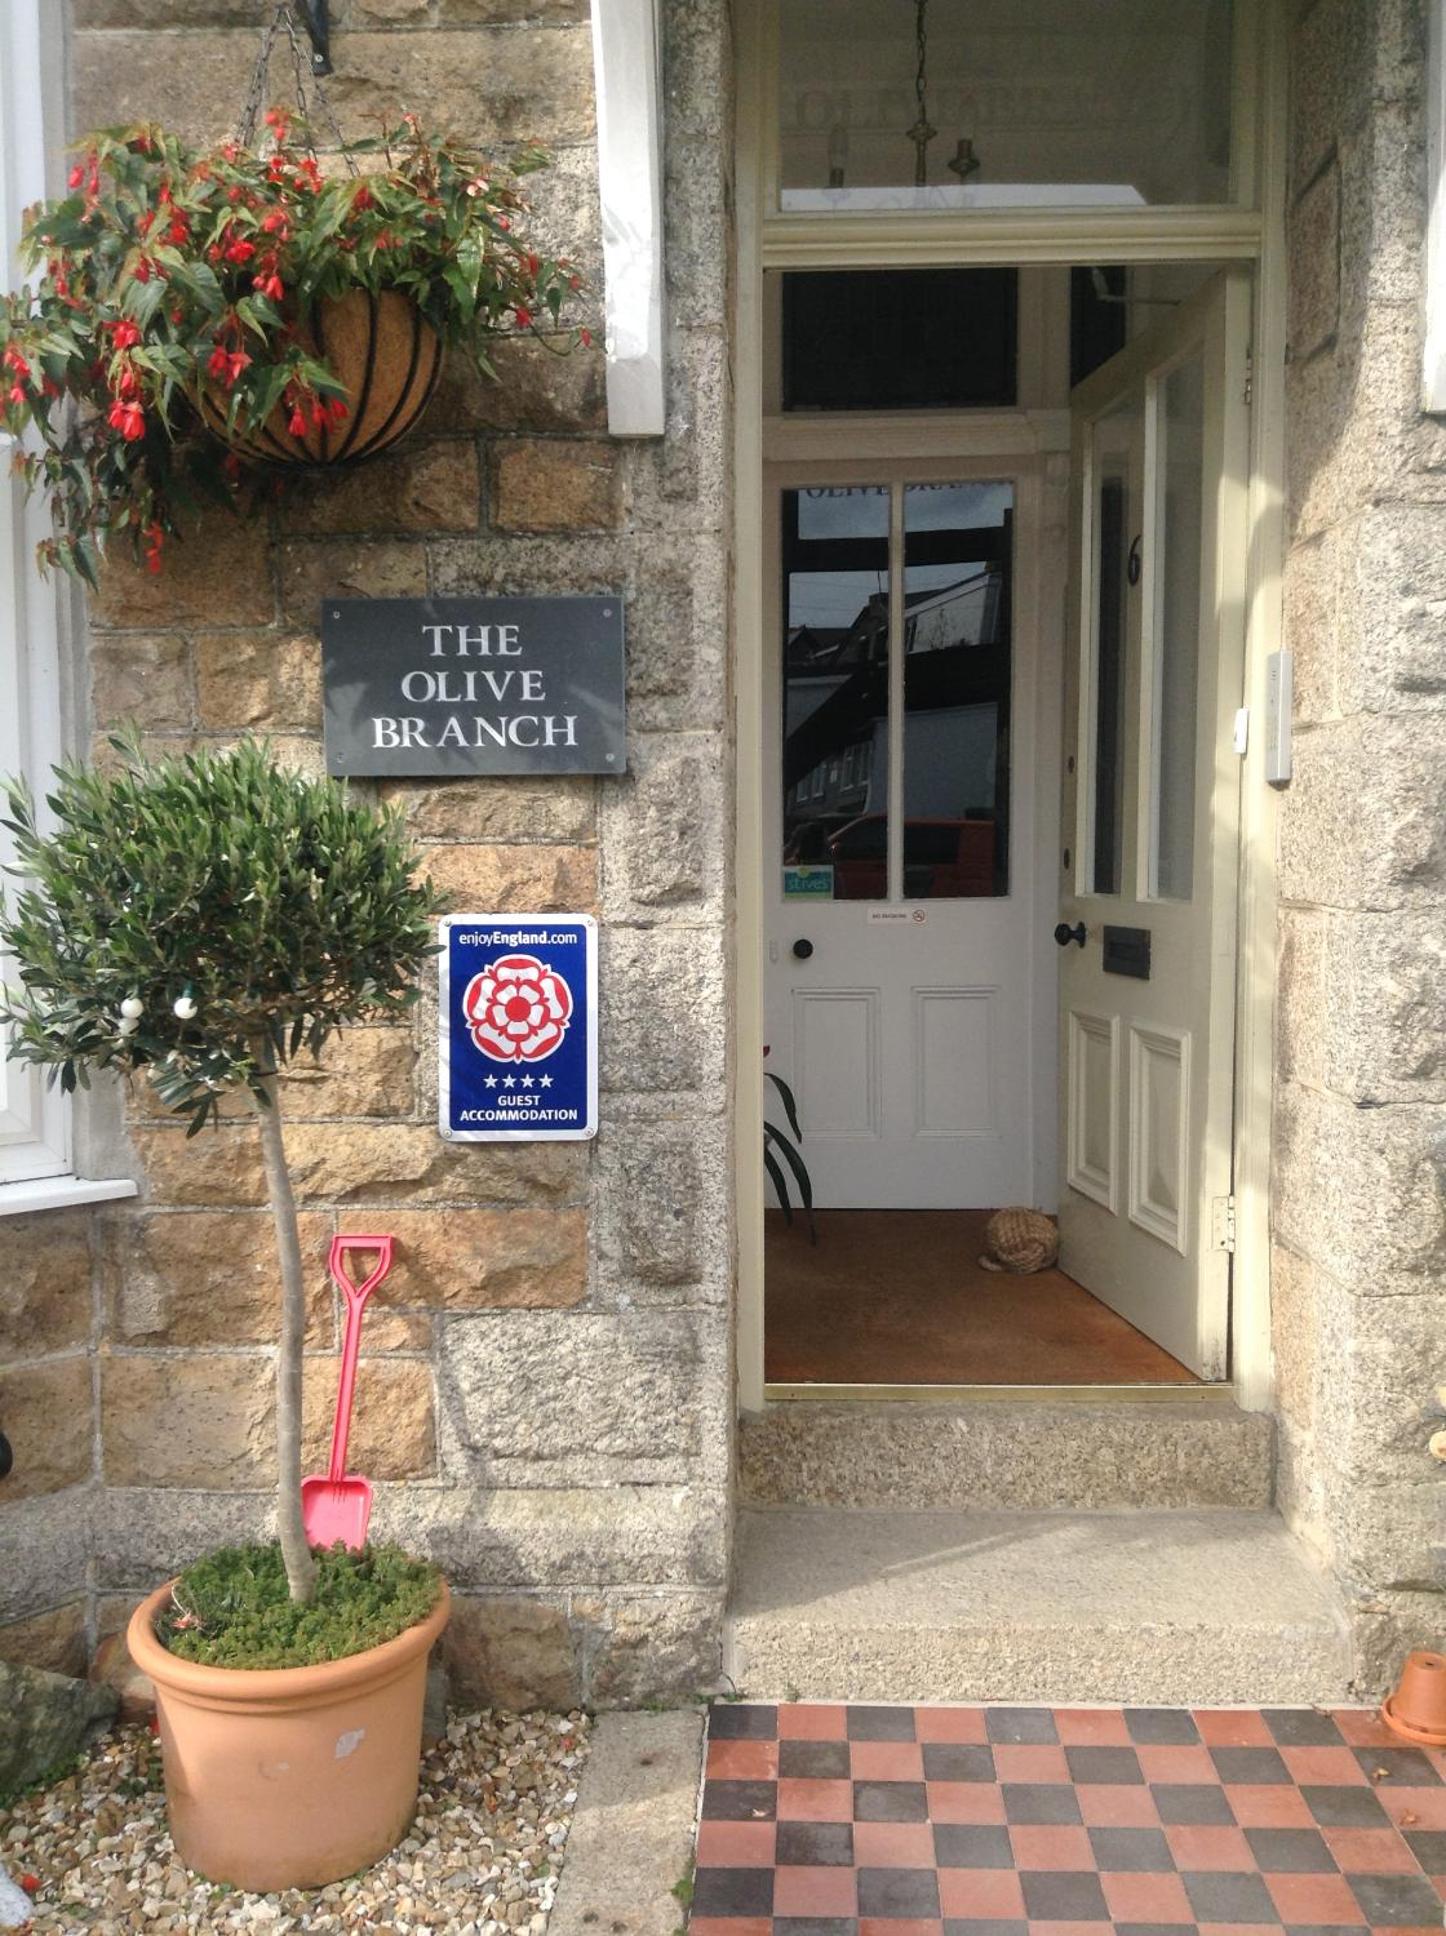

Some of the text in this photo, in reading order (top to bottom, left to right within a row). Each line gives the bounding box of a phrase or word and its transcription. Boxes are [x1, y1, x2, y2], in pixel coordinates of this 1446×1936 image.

[422, 625, 523, 656] THE
[401, 670, 546, 702] OLIVE
[372, 715, 578, 748] BRANCH
[459, 931, 577, 946] enjoyEngland.com
[497, 1095, 541, 1106] GUEST
[460, 1109, 578, 1121] ACCOMMODATION
